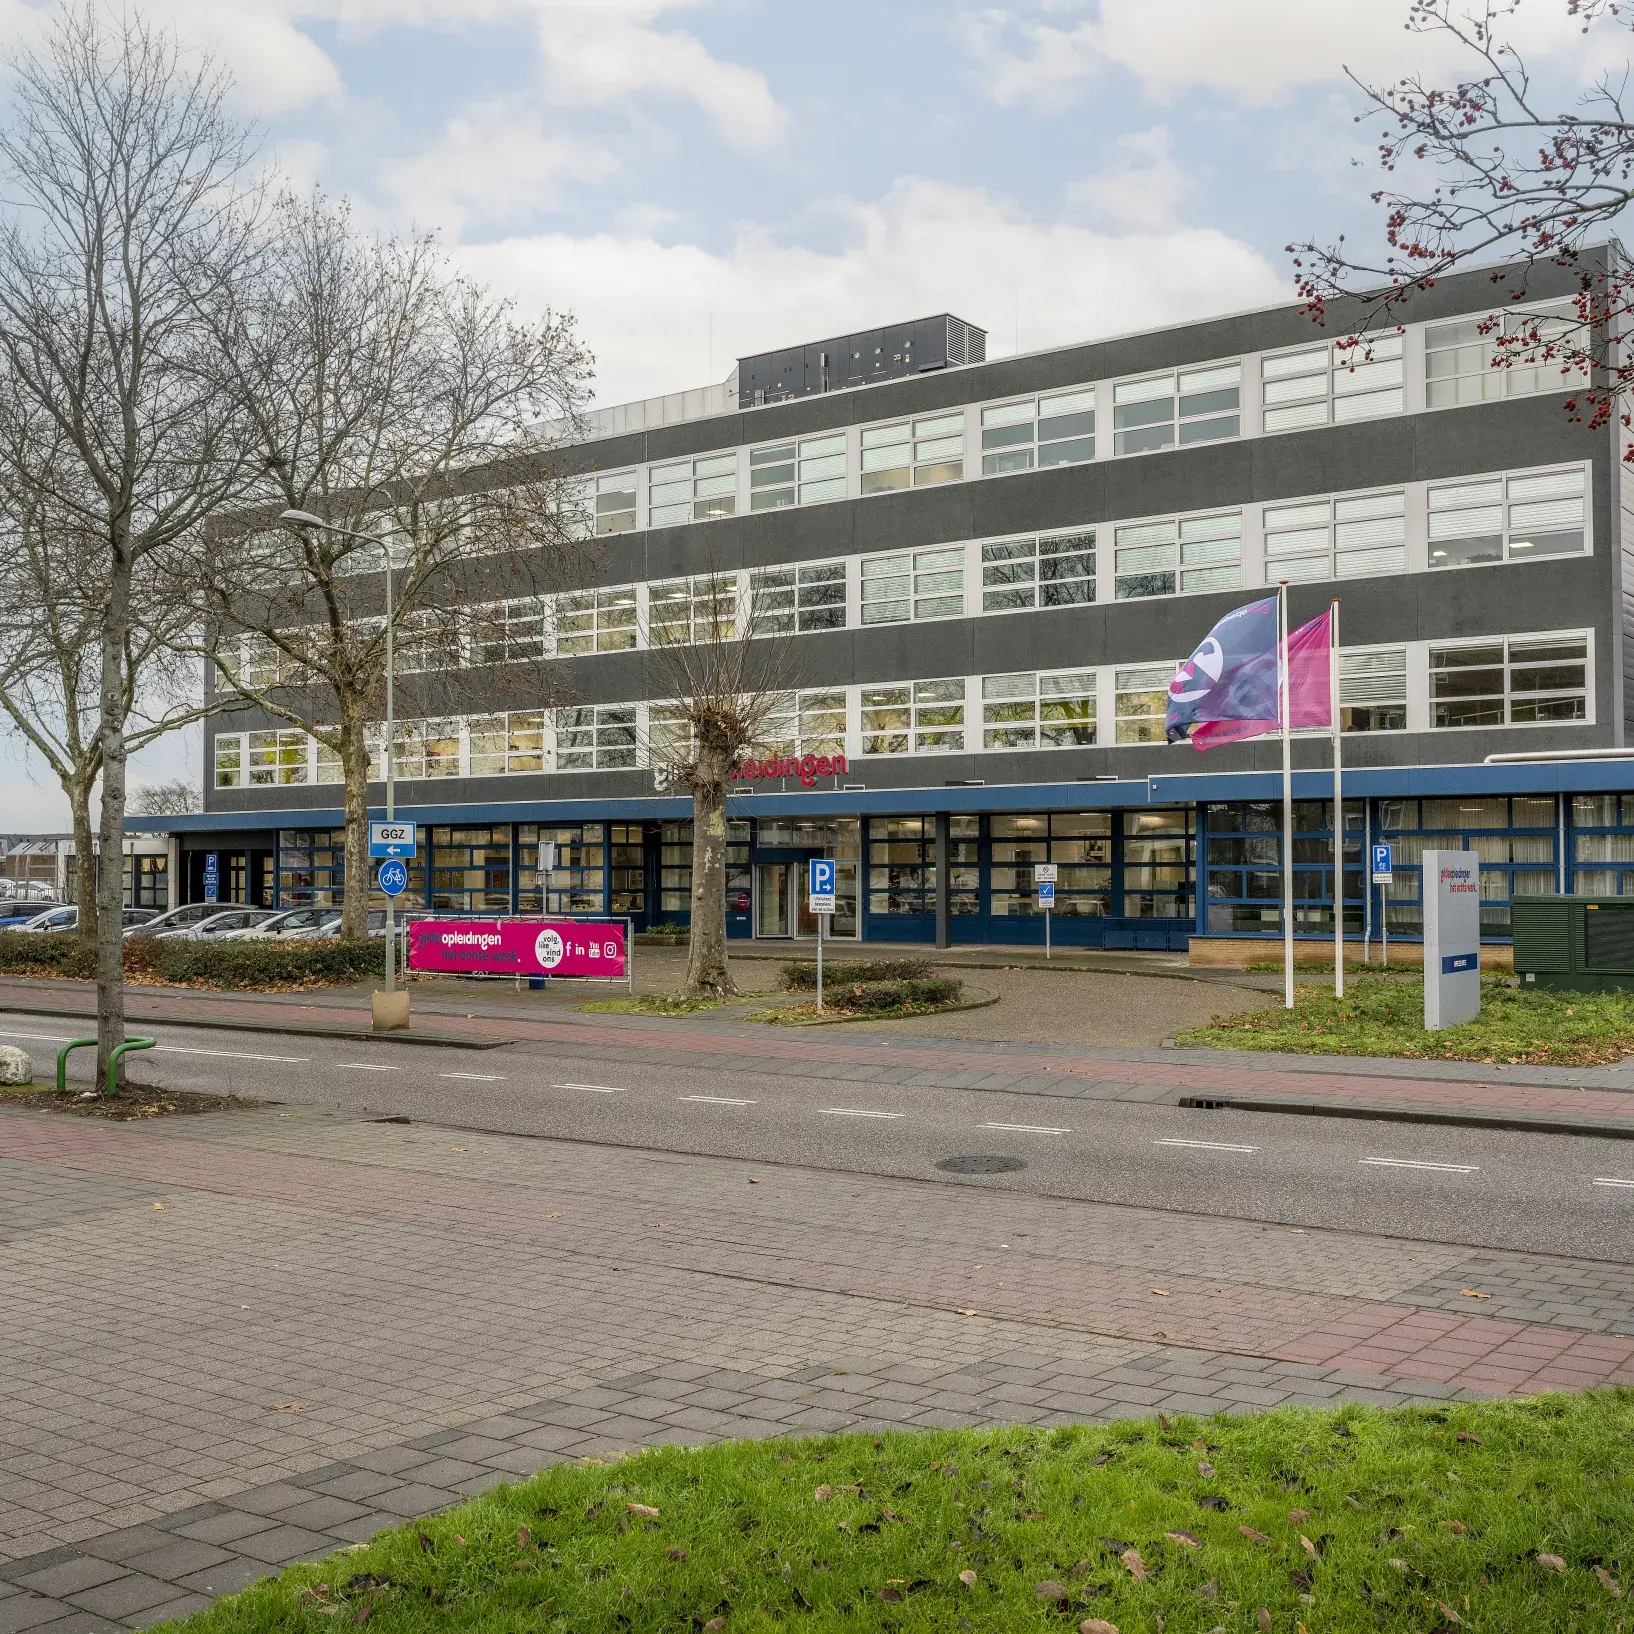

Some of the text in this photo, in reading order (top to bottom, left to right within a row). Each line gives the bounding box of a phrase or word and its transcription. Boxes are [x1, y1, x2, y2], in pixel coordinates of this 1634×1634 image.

[381, 829, 405, 839] GGZ
[1376, 848, 1387, 862] P
[209, 857, 214, 866] P
[816, 864, 830, 891] P
[589, 941, 600, 949] You
[441, 949, 457, 960] het
[460, 949, 488, 961] echte
[546, 949, 561, 957] vind
